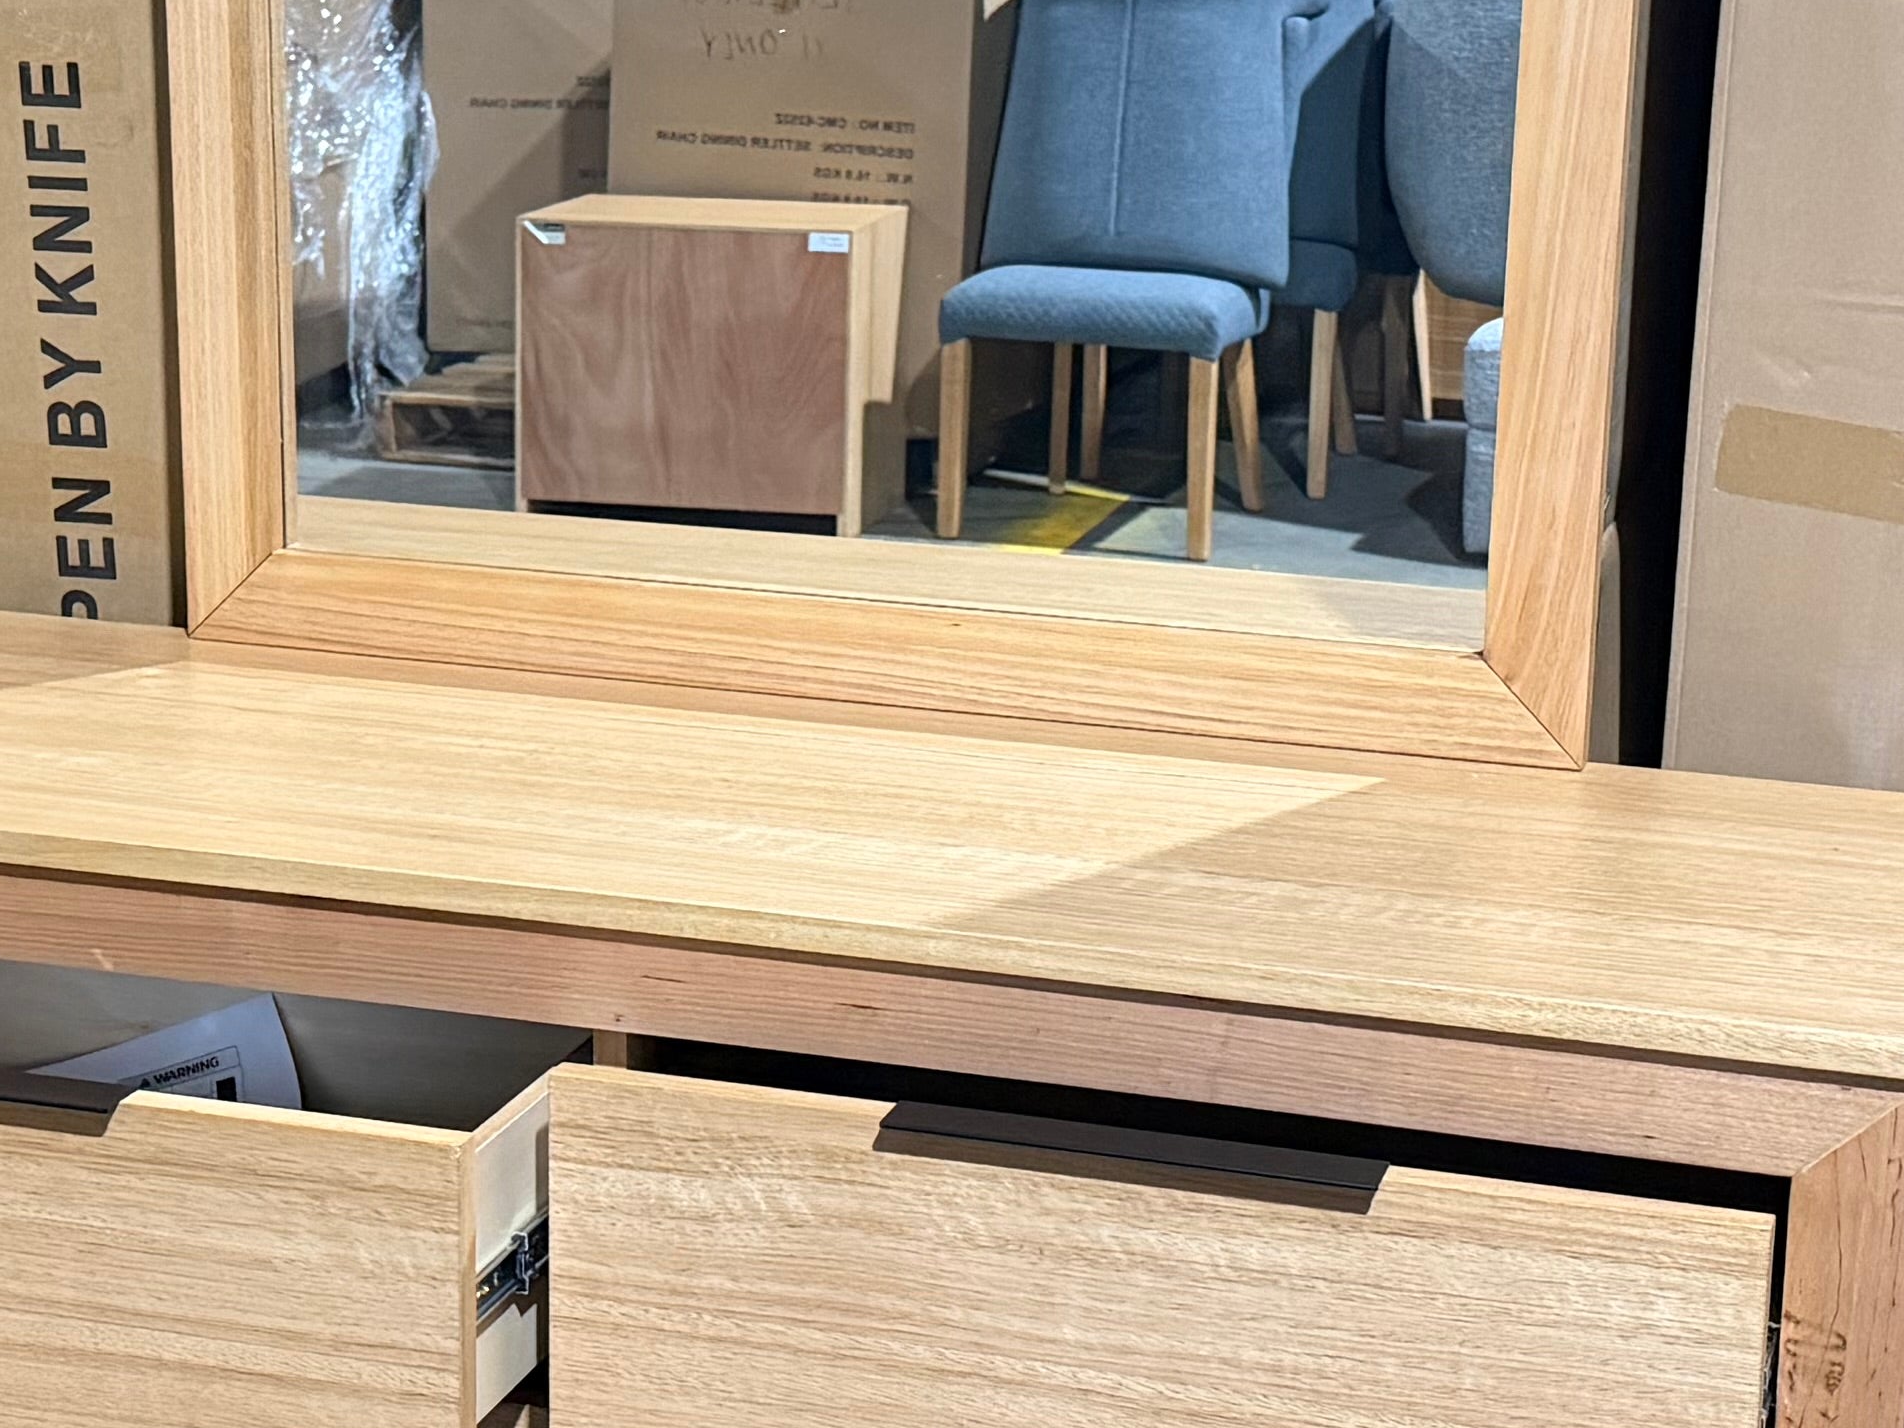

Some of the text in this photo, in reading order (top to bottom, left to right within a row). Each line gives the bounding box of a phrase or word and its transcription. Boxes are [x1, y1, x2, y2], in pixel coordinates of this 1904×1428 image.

[19, 60, 97, 315] KNIFE
[40, 337, 107, 449] BY
[153, 1056, 220, 1084] WARNING
